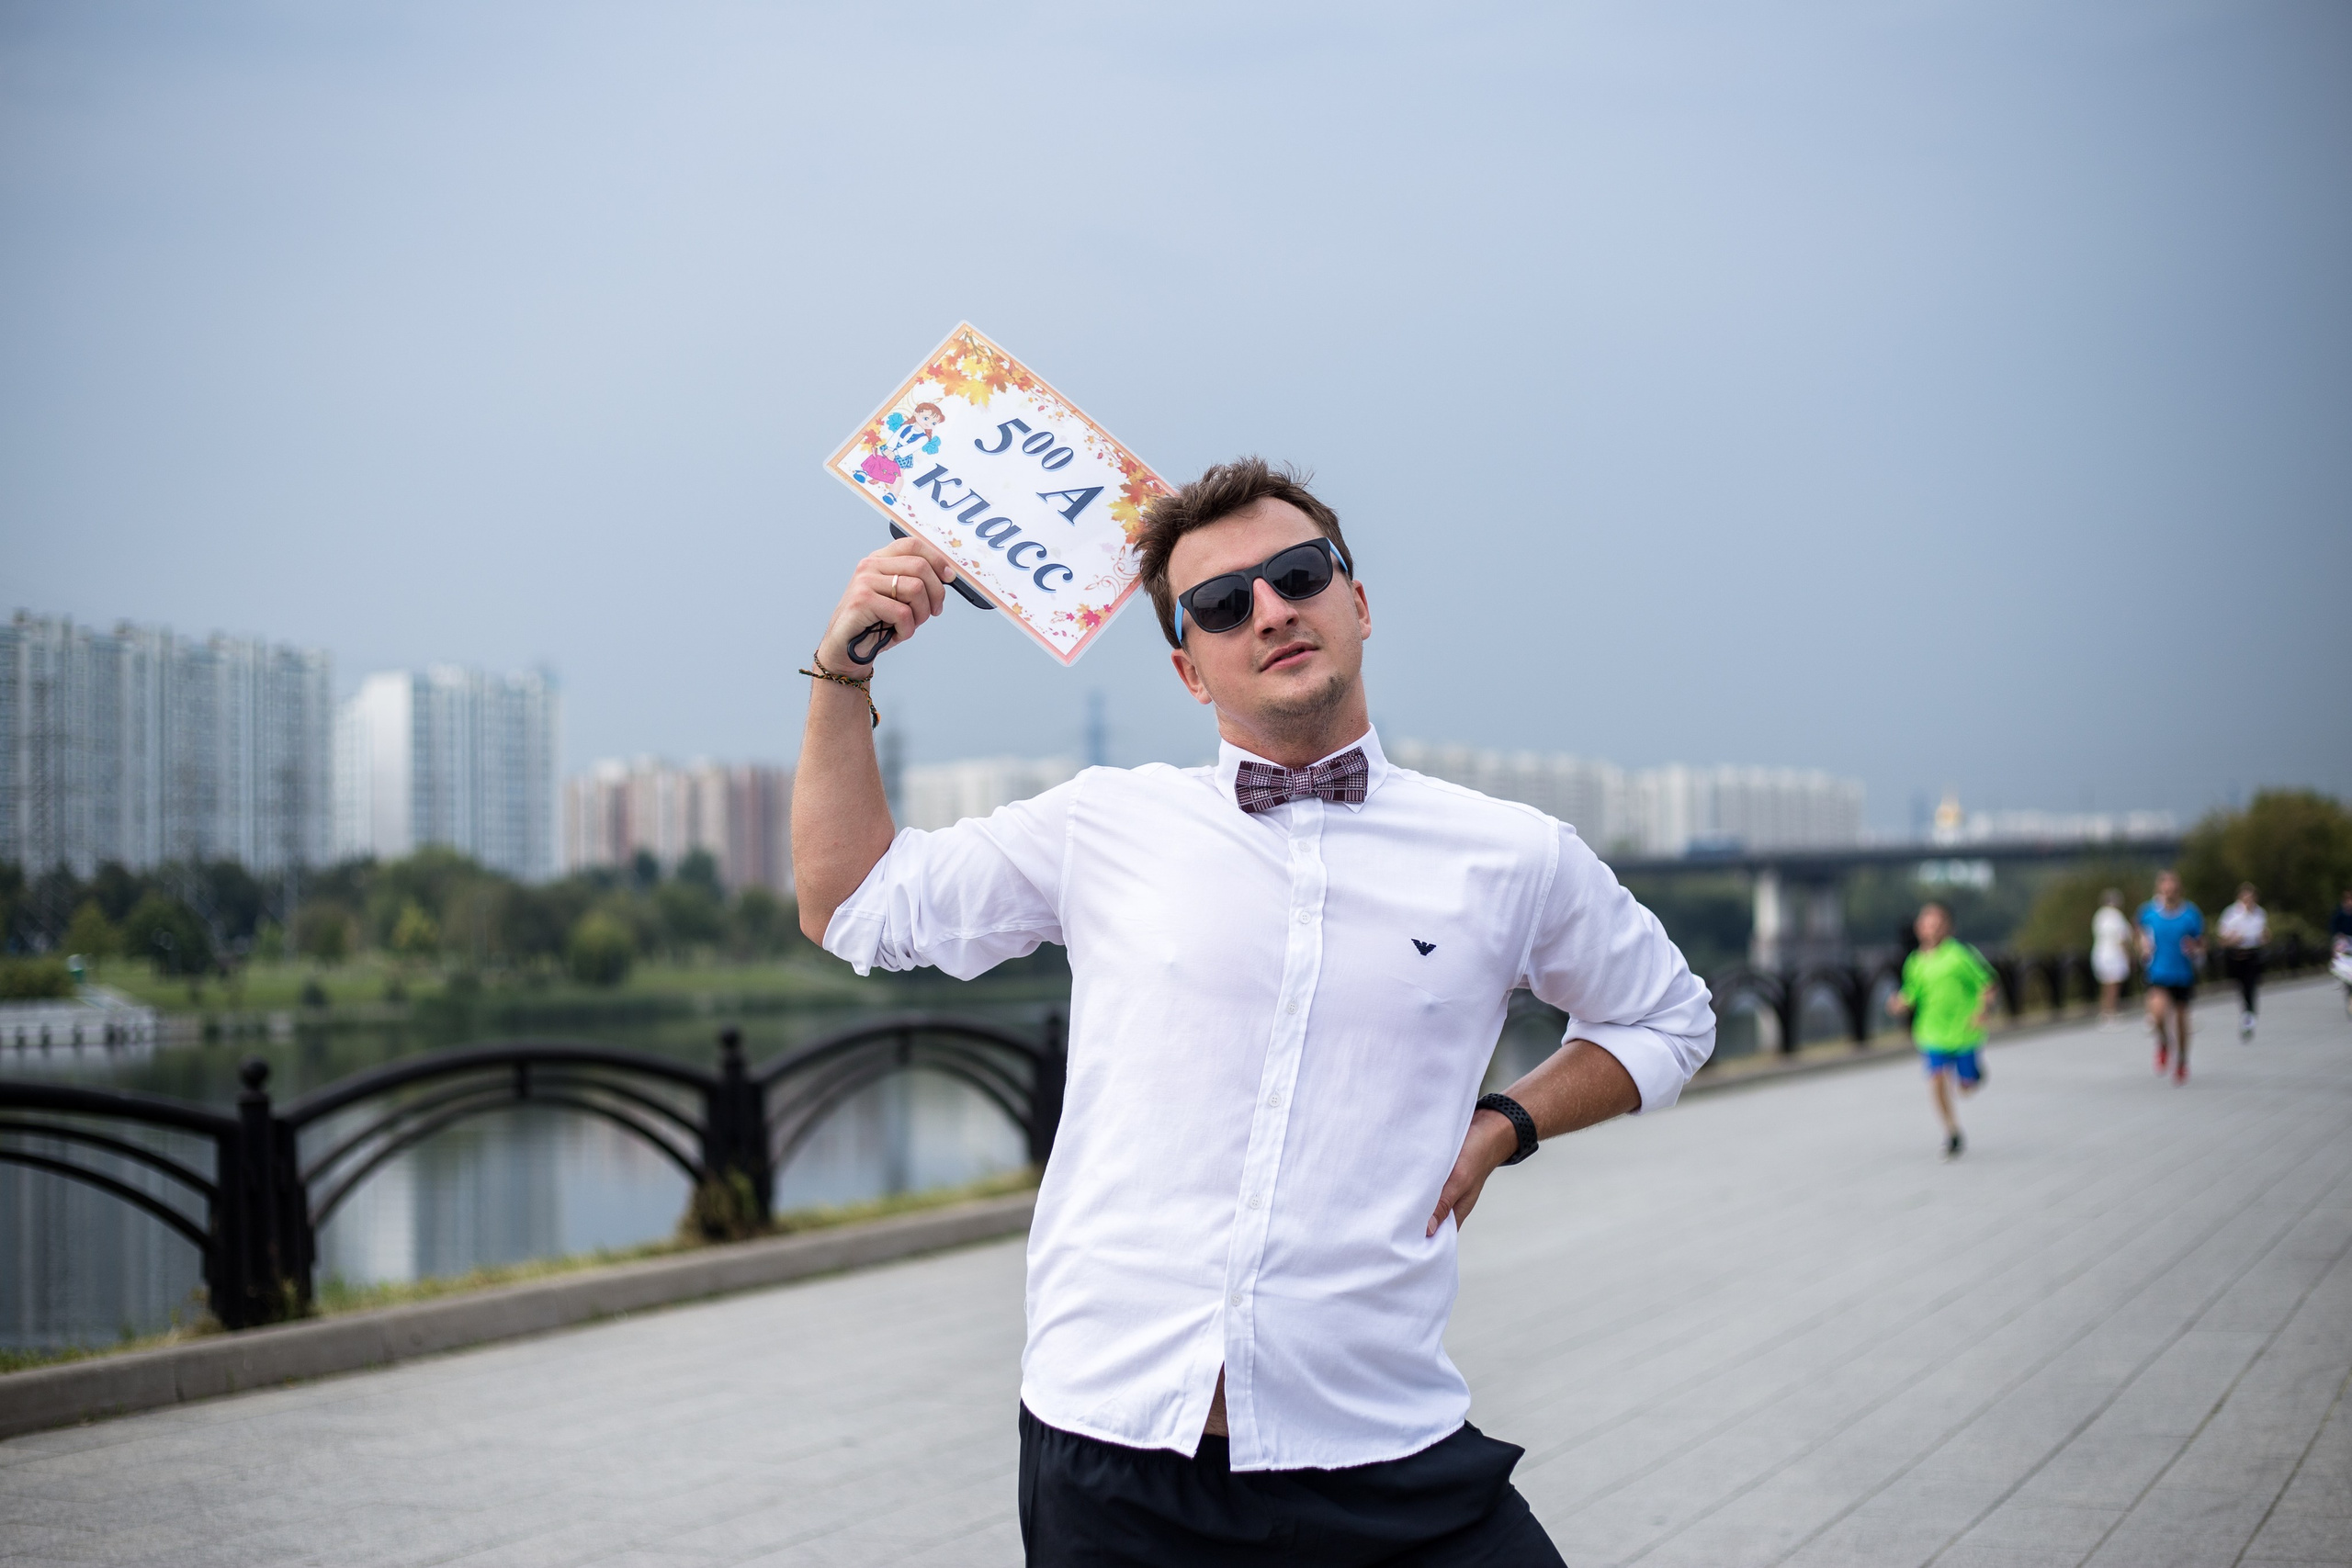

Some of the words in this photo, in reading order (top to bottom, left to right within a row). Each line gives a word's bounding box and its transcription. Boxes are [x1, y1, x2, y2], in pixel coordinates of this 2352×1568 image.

[912, 463, 1074, 592] класс
[975, 418, 1074, 471] 500
[1036, 485, 1104, 526] А
